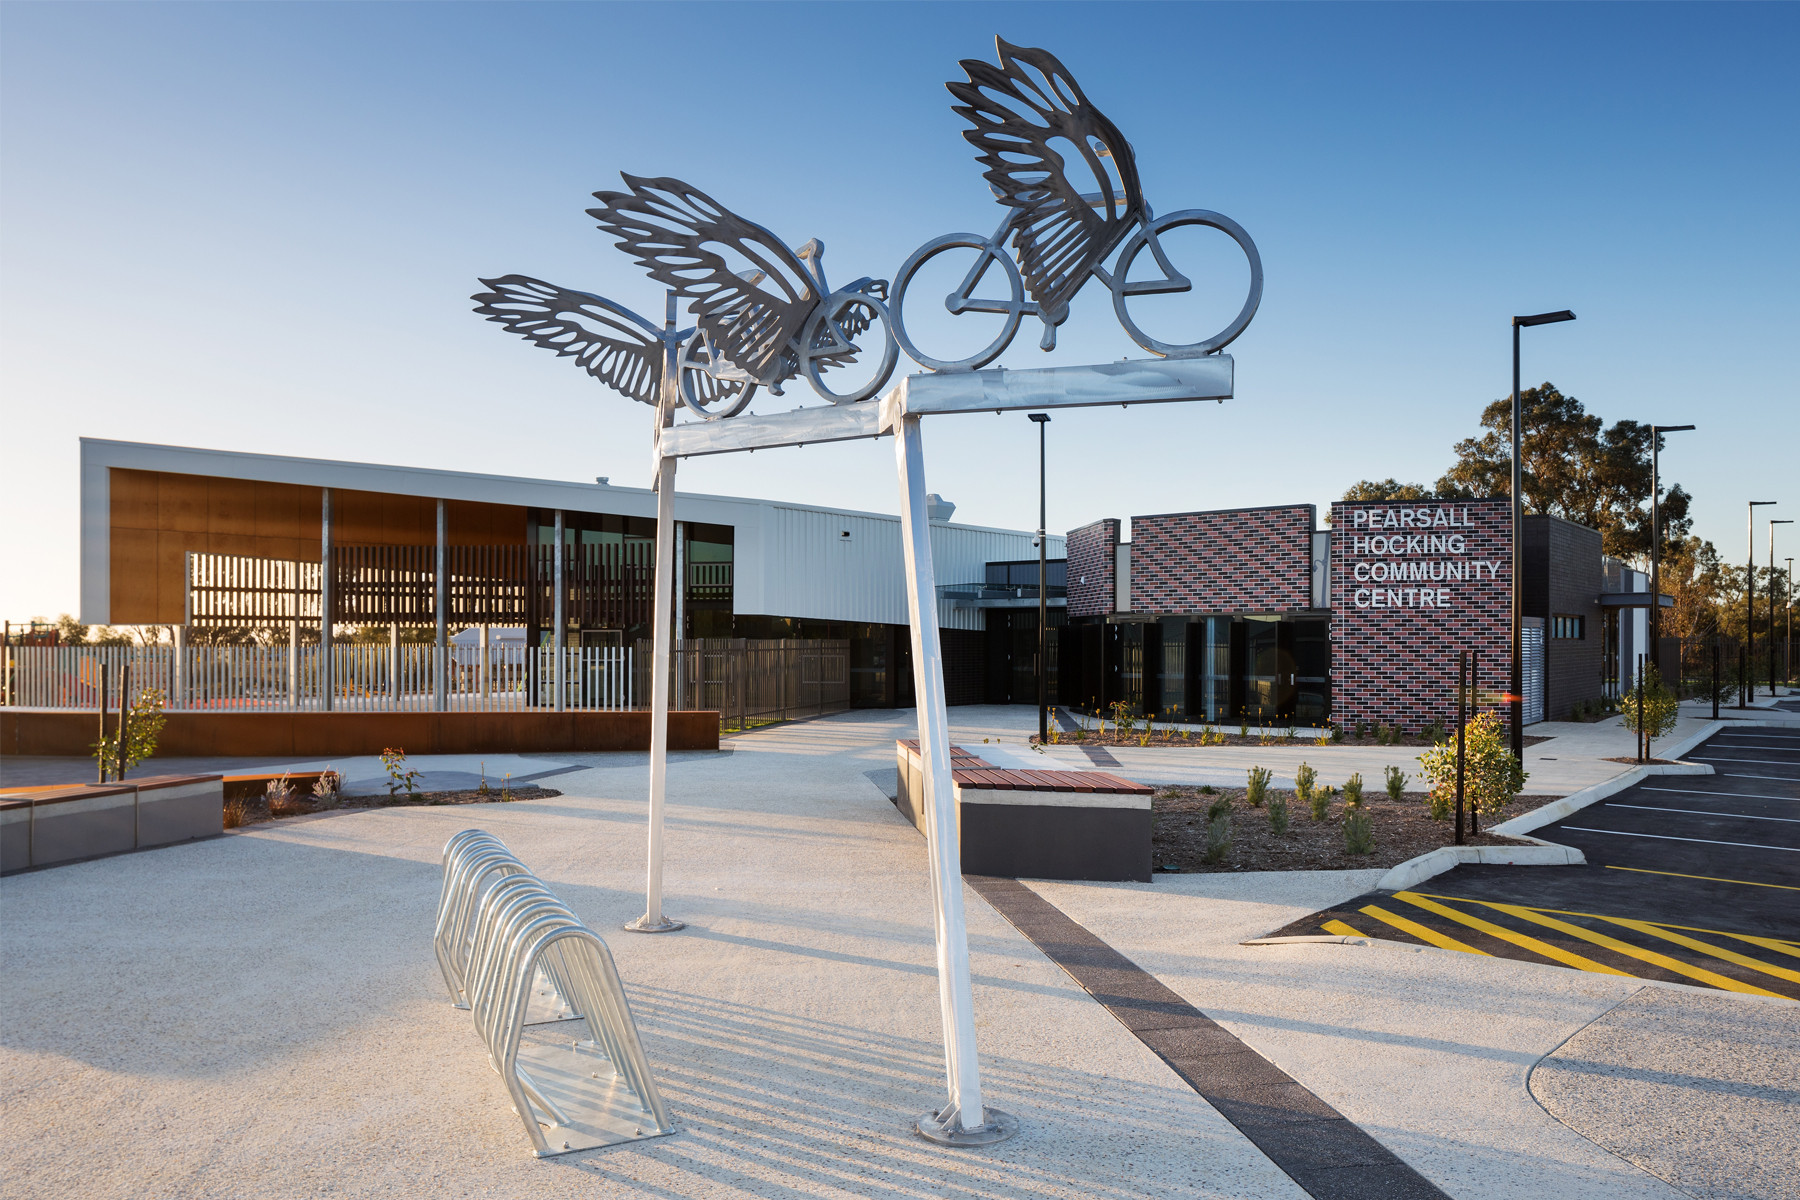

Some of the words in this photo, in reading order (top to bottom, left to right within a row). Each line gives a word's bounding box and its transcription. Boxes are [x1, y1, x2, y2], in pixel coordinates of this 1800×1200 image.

[1354, 508, 1475, 528] PEARSALL
[1354, 535, 1465, 554] HOCKING
[1354, 560, 1501, 581] COMMUNITY
[1355, 588, 1451, 608] CENTRE
